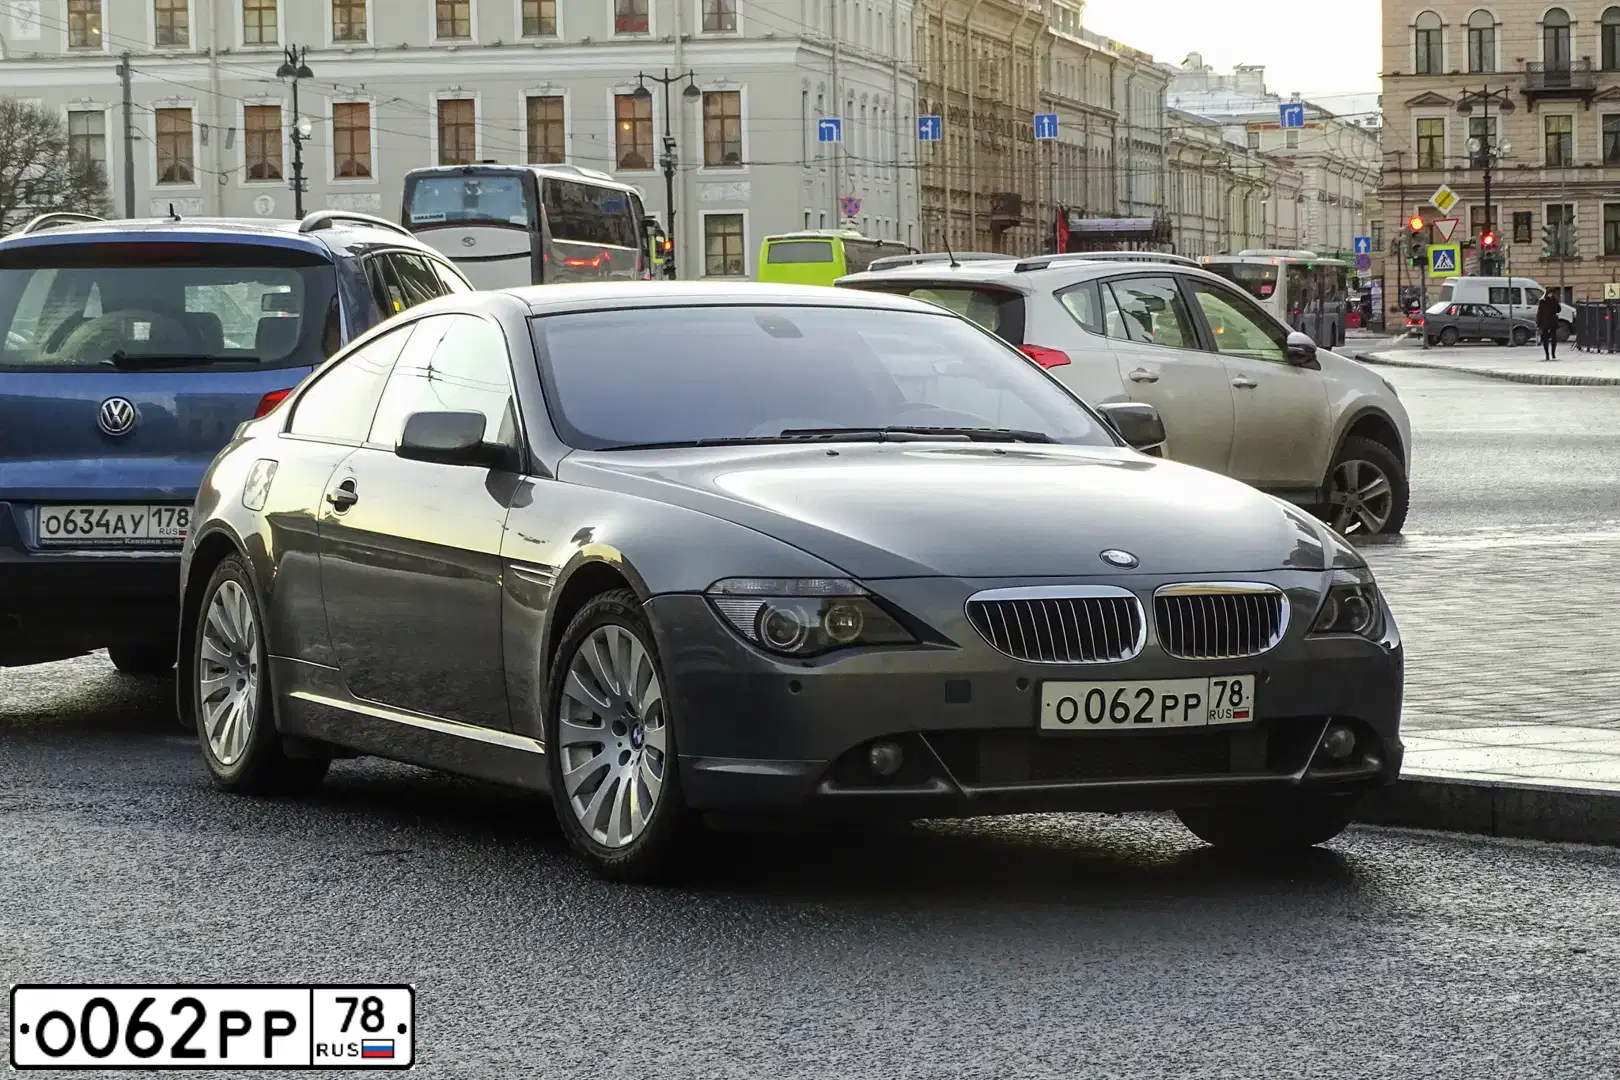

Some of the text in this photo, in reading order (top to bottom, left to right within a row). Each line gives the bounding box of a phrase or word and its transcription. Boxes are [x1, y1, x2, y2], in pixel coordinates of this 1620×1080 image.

[46, 507, 189, 535] О634АУ 178
[1056, 679, 1244, 725] О062РР 78
[1209, 708, 1233, 720] RUS
